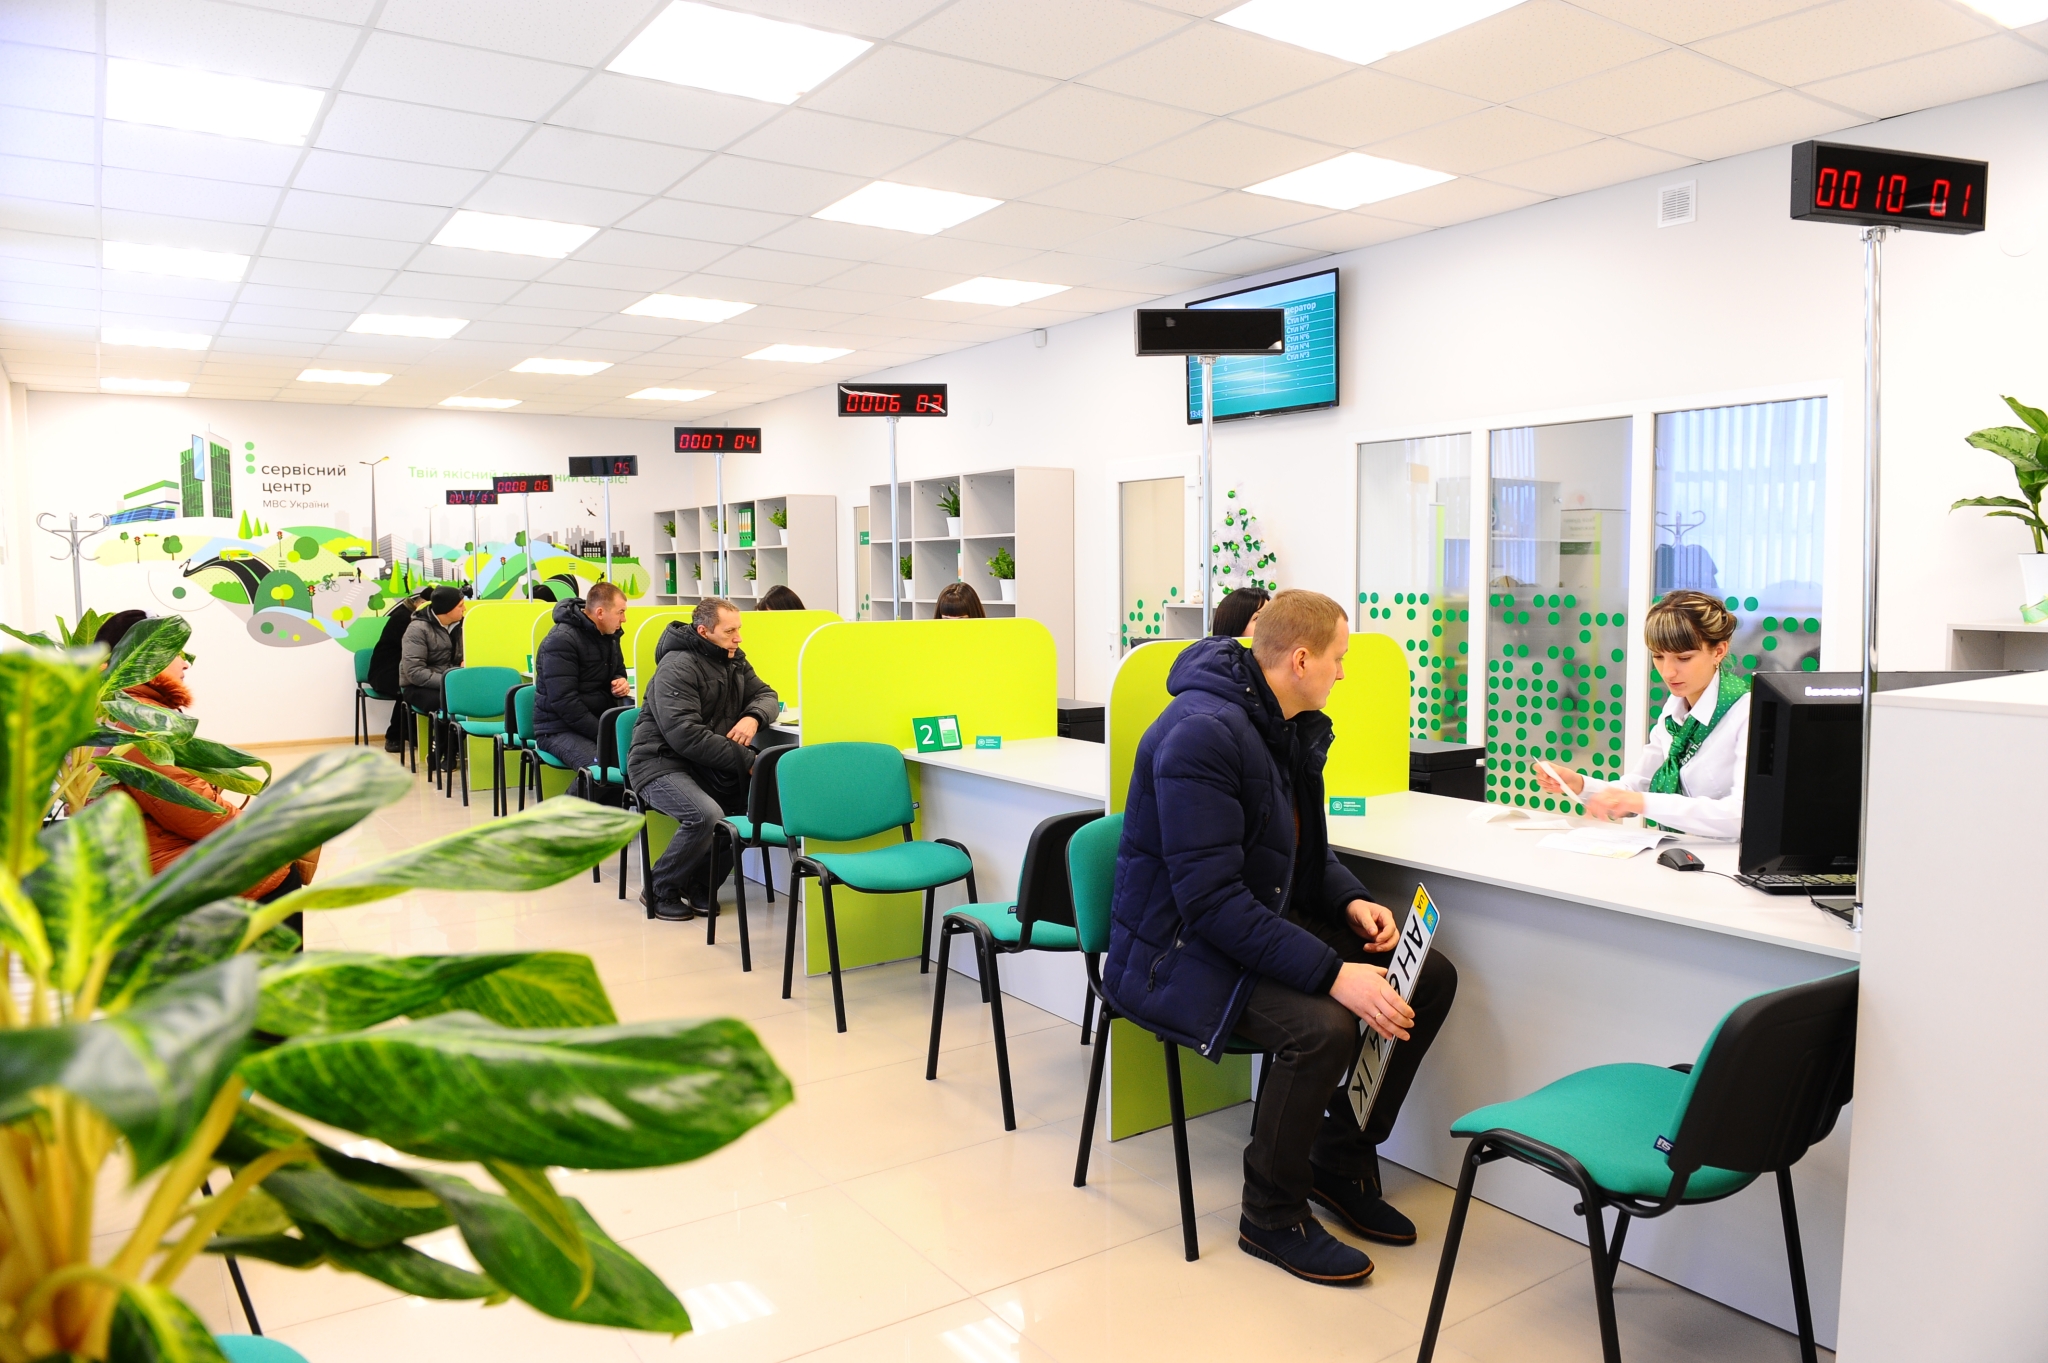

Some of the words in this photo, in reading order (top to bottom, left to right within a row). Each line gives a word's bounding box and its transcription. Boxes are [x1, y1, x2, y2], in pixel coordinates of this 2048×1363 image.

[1816, 167, 1907, 213] 0010
[1929, 179, 1972, 217] 01
[1285, 302, 1316, 314] ператор
[846, 393, 901, 412] 0006
[916, 394, 943, 413] 03
[679, 434, 724, 449] 0007
[734, 435, 756, 449] 04
[261, 463, 347, 478] сервісний
[408, 466, 438, 479] Твій
[443, 468, 497, 480] якісний
[613, 462, 630, 475] 05
[262, 482, 312, 495] центр
[497, 480, 527, 493] 0008
[533, 480, 549, 491] 06
[262, 499, 287, 508] МВС
[289, 500, 330, 510] України
[919, 724, 934, 745] 2
[1416, 894, 1425, 910] UA
